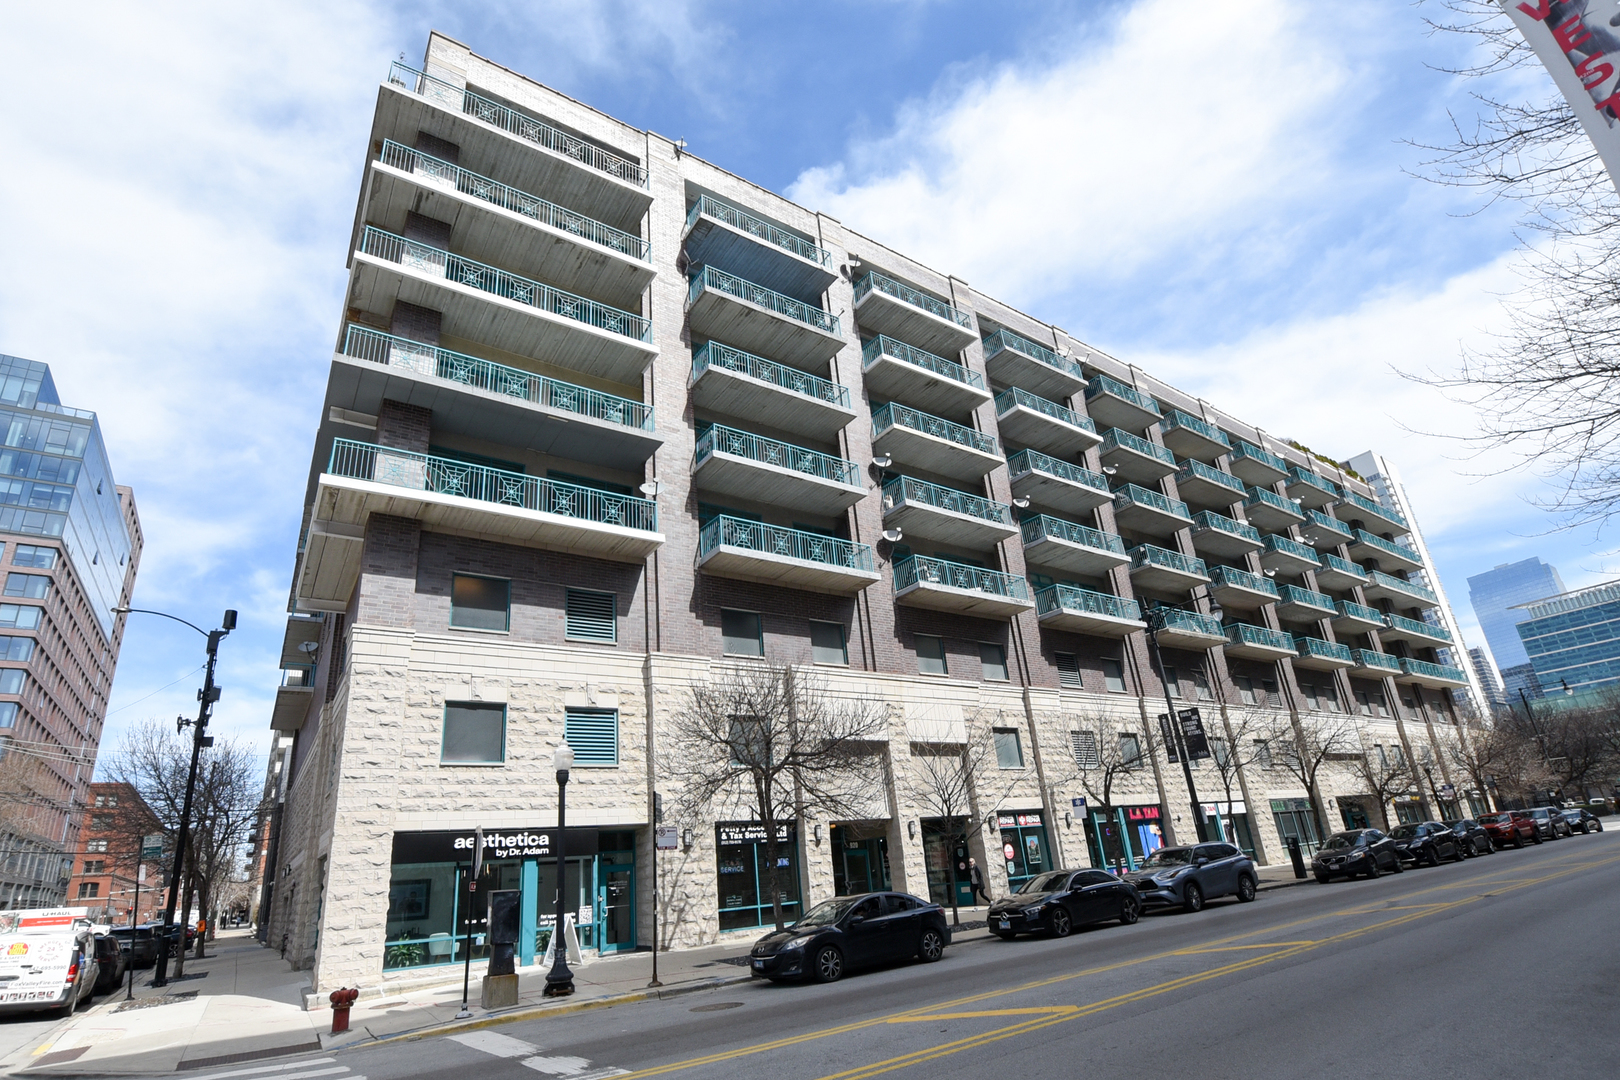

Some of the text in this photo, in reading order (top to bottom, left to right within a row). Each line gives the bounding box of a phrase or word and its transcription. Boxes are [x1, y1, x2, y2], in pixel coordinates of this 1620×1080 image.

[1143, 807, 1159, 818] TAN
[721, 832, 727, 840] &
[745, 831, 772, 839] Servic
[495, 847, 549, 858] by Dr. Adam
